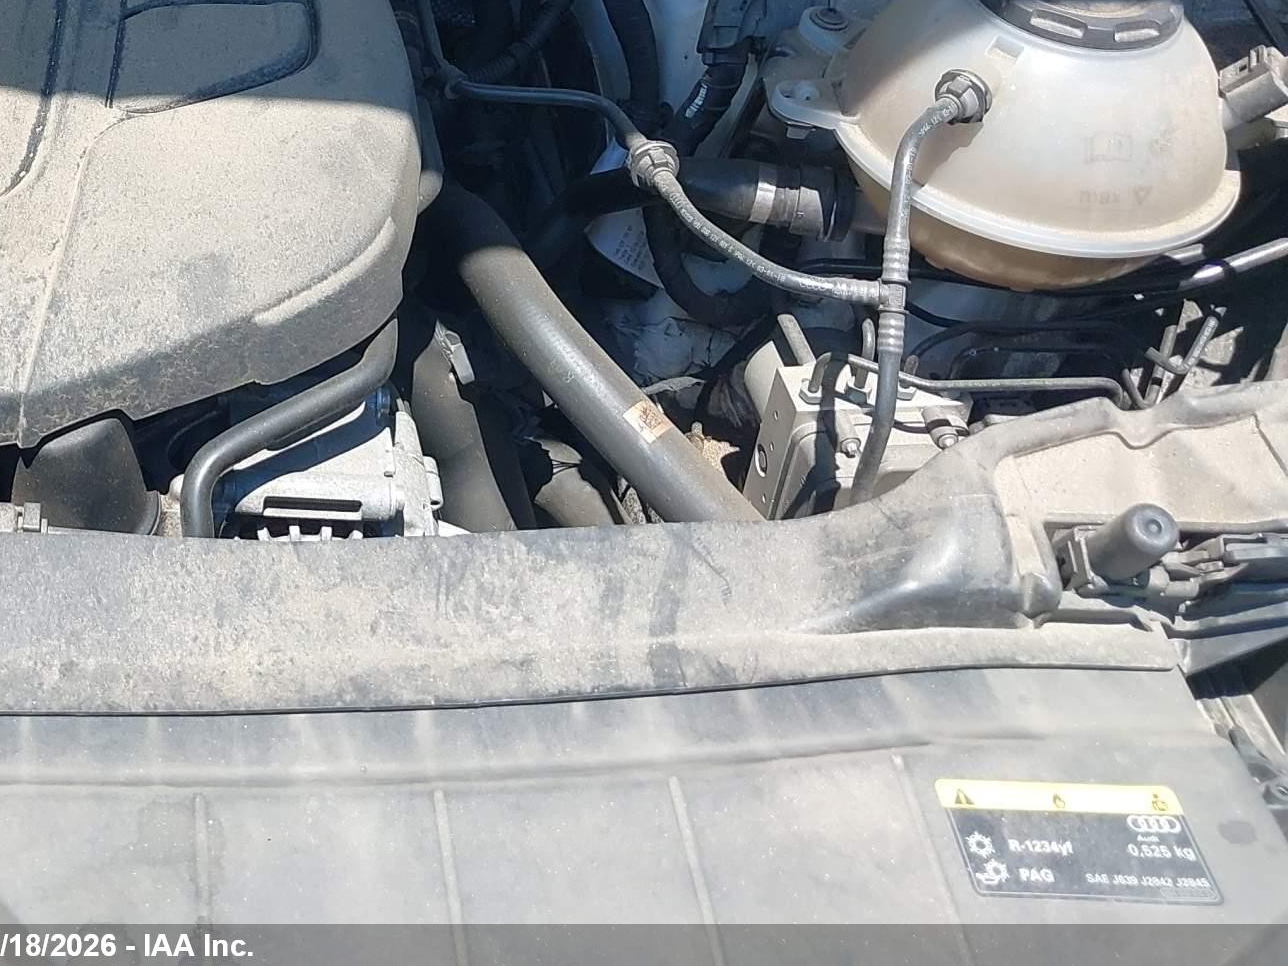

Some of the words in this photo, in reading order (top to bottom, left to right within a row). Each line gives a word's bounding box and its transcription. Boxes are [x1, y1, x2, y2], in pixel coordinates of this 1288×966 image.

[1008, 838, 1074, 856] R-1234yf
[1173, 845, 1197, 862] kg
[1018, 867, 1055, 884] PAG
[1085, 873, 1110, 884] SAE
